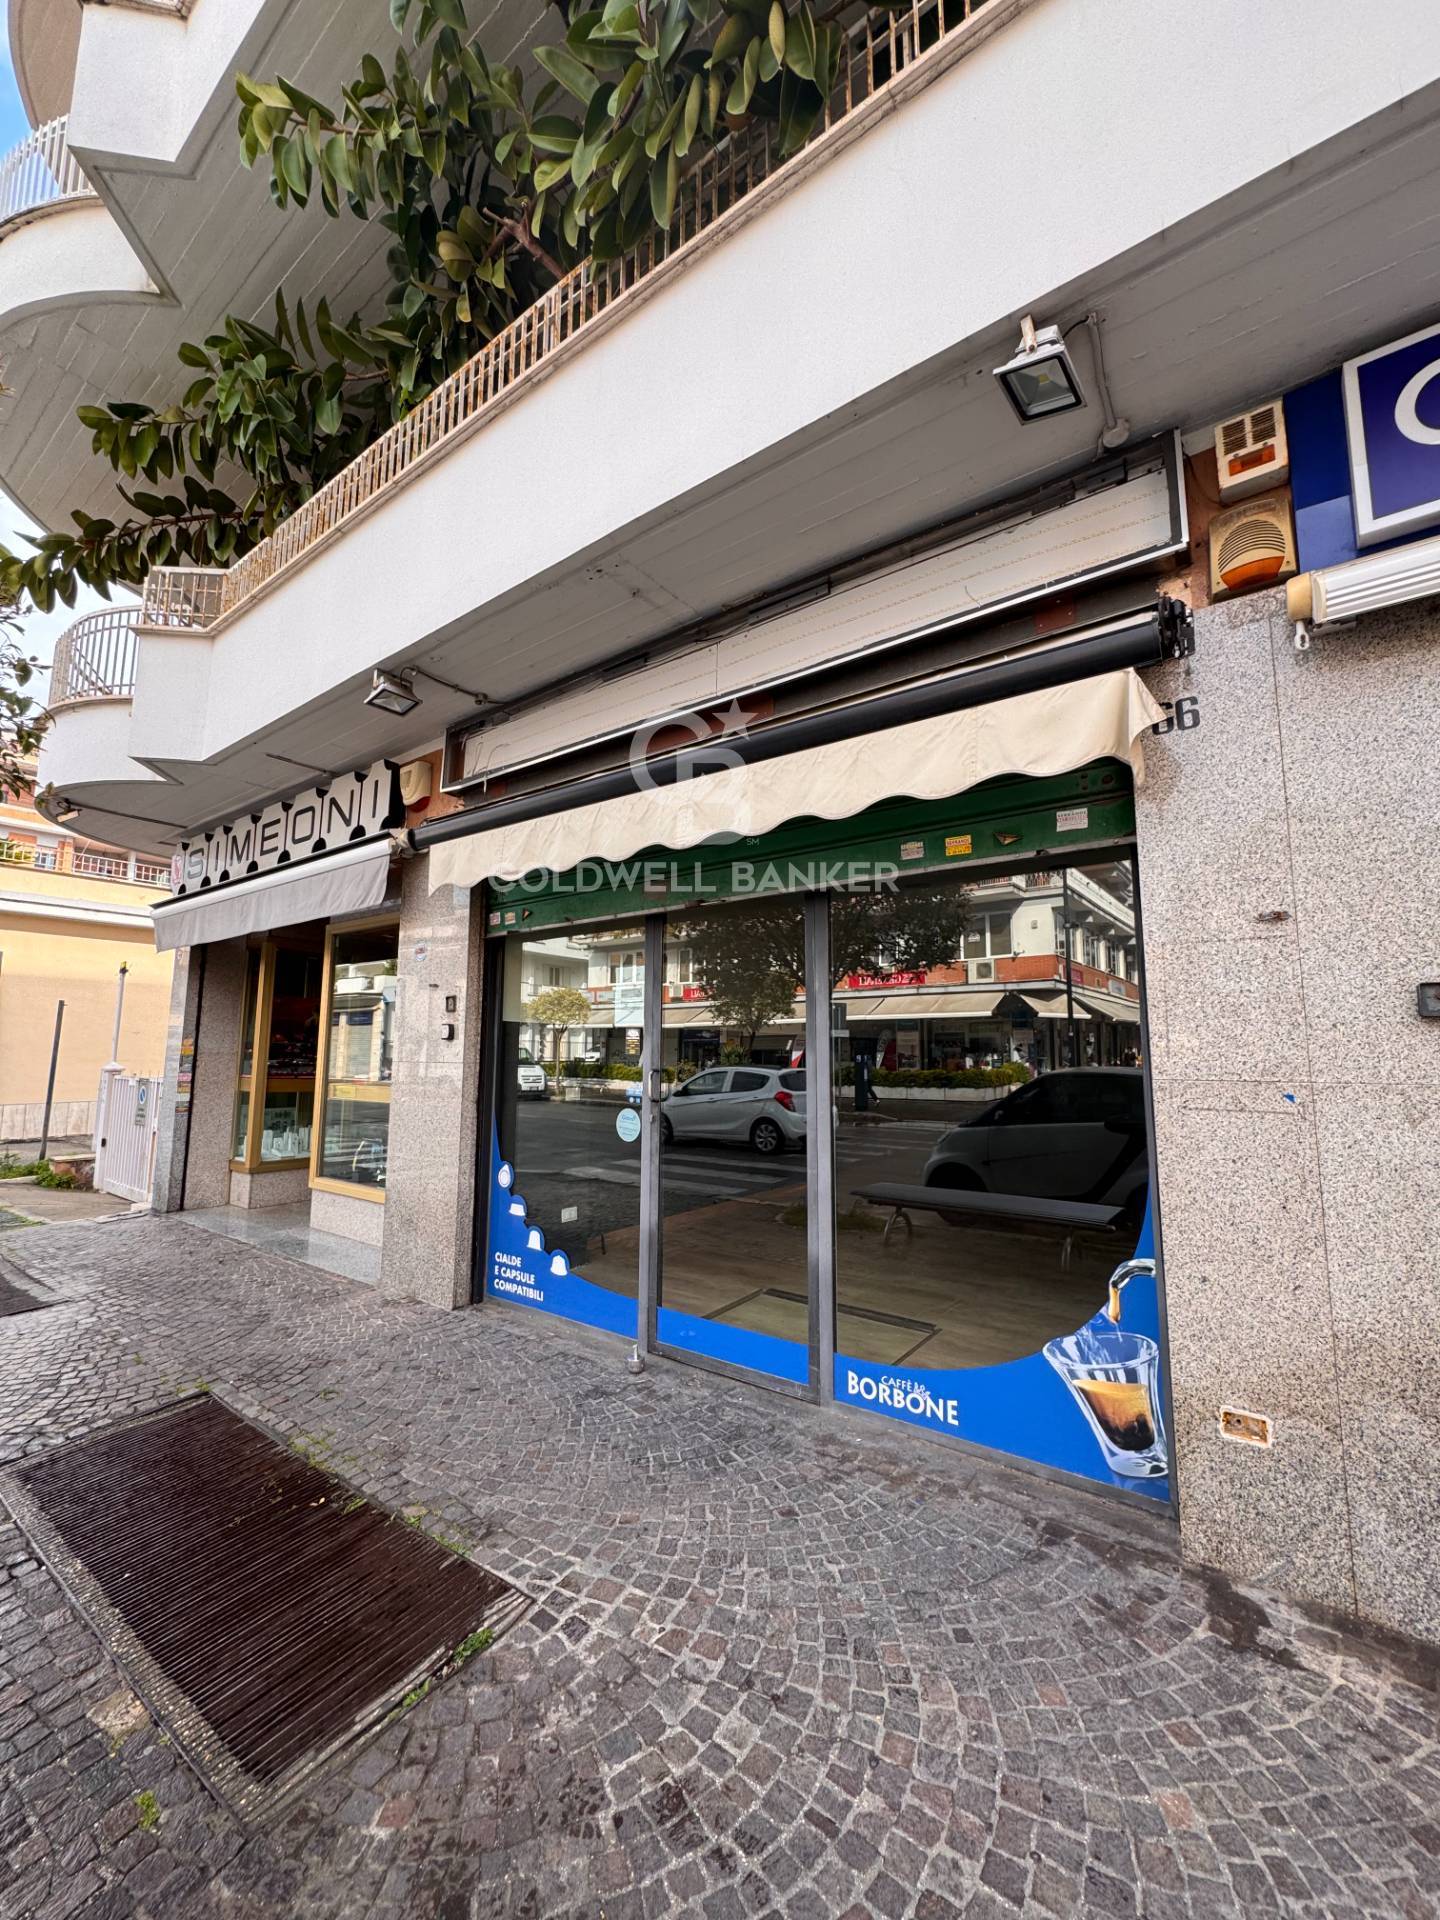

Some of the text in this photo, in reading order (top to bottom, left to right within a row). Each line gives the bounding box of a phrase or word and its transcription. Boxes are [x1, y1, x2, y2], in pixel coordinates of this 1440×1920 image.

[188, 779, 379, 880] SIMEONI
[494, 1251, 522, 1268] CIALDE
[494, 1265, 535, 1285] E CAPSULE
[493, 1278, 544, 1302] COMPATIBILI
[880, 1375, 913, 1393] CAFFÈ
[847, 1369, 960, 1427] BORBONE
